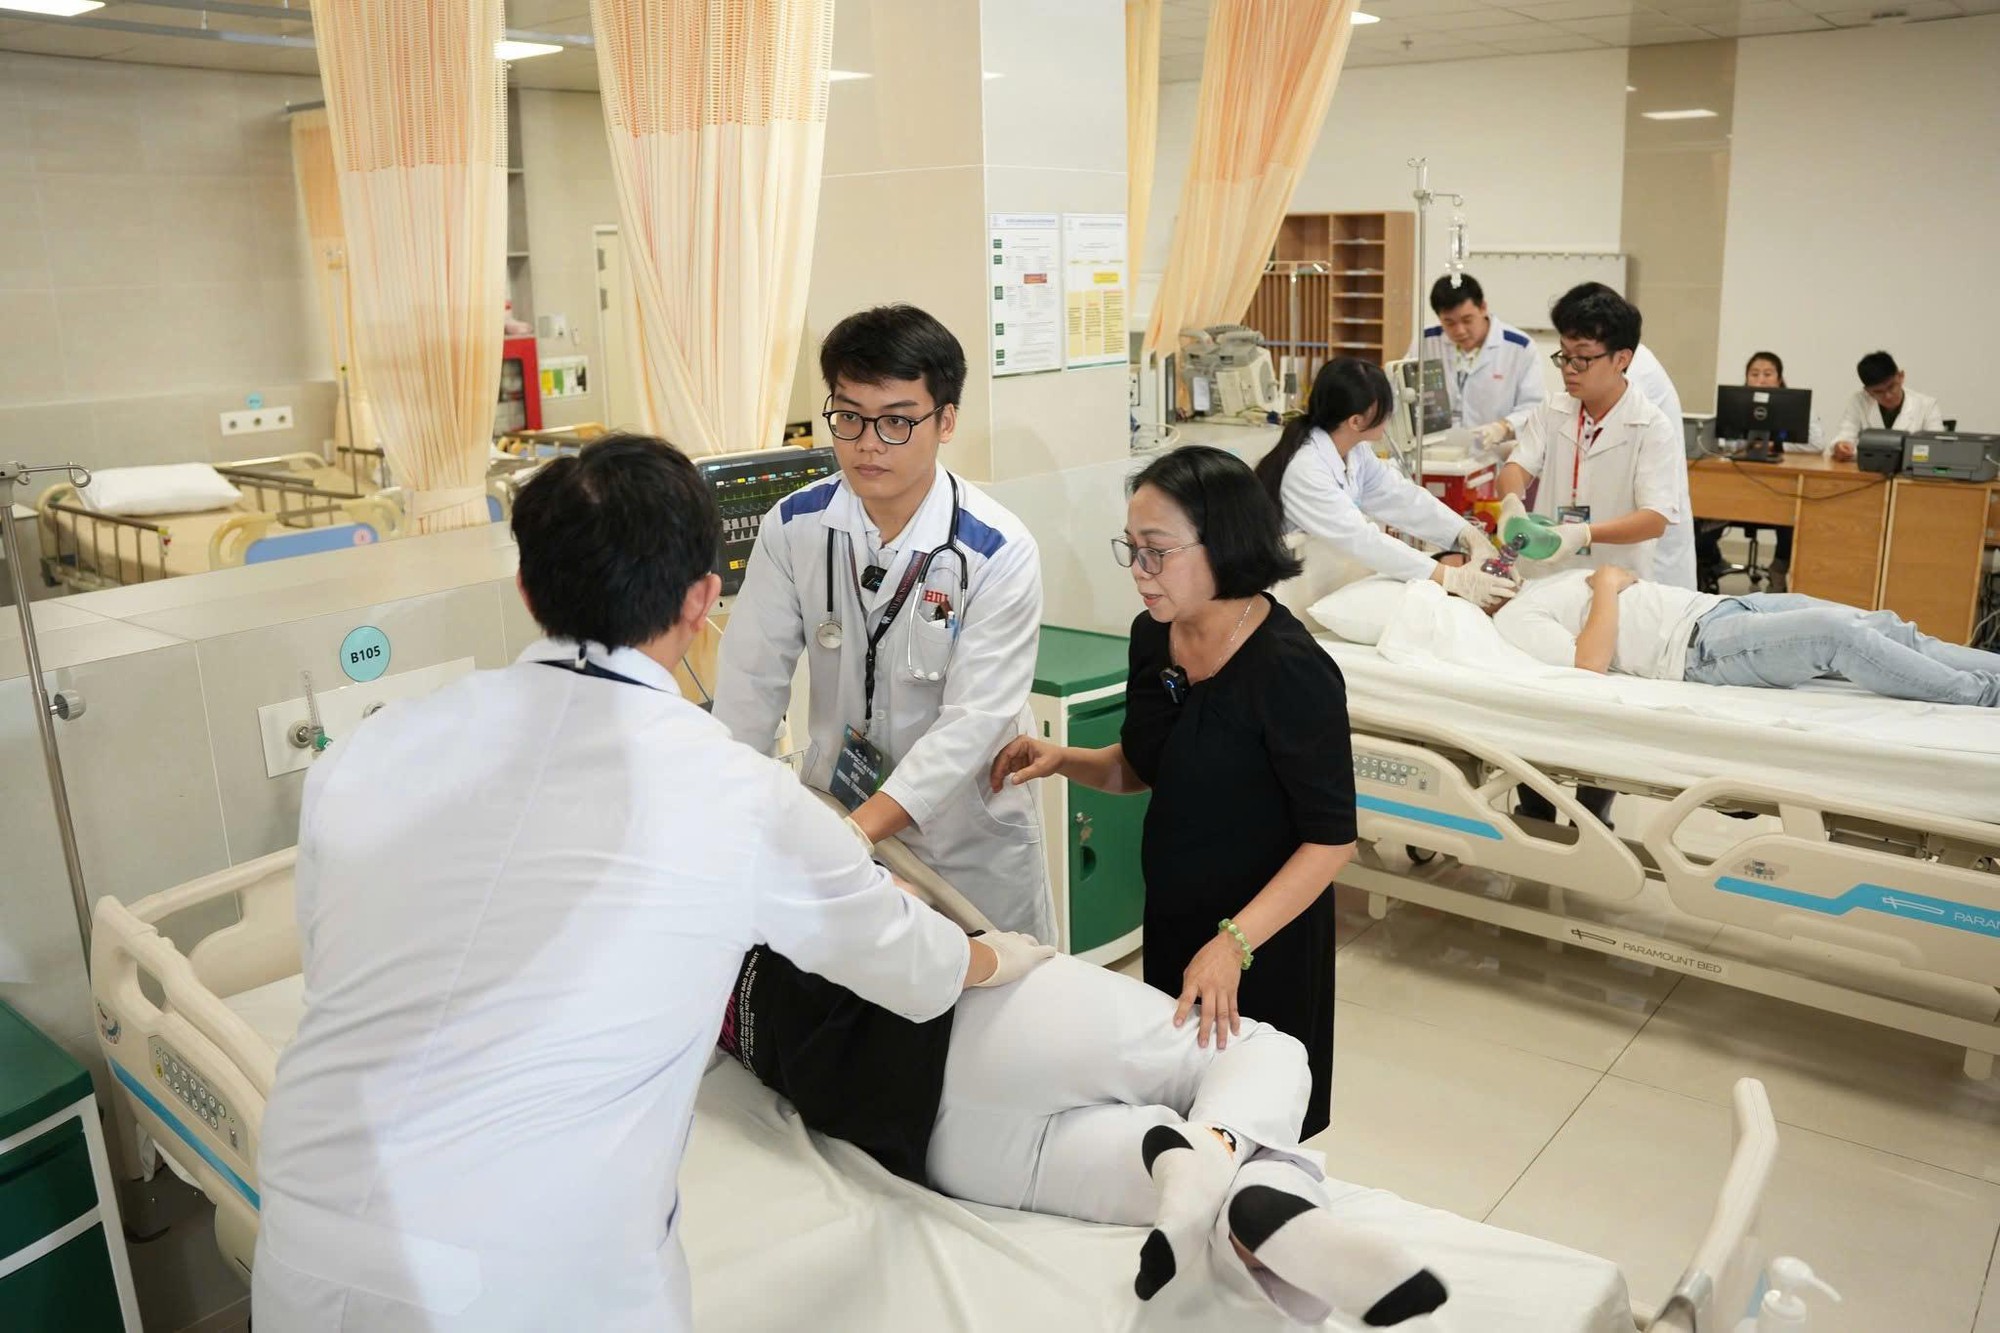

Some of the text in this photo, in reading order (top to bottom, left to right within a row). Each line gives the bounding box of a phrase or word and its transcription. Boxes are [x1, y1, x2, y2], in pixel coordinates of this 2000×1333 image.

[350, 645, 381, 664] B105
[744, 950, 760, 977] RABBIT
[1623, 942, 1722, 973] PARAMOUNT BED
[745, 970, 757, 999] FASHION
